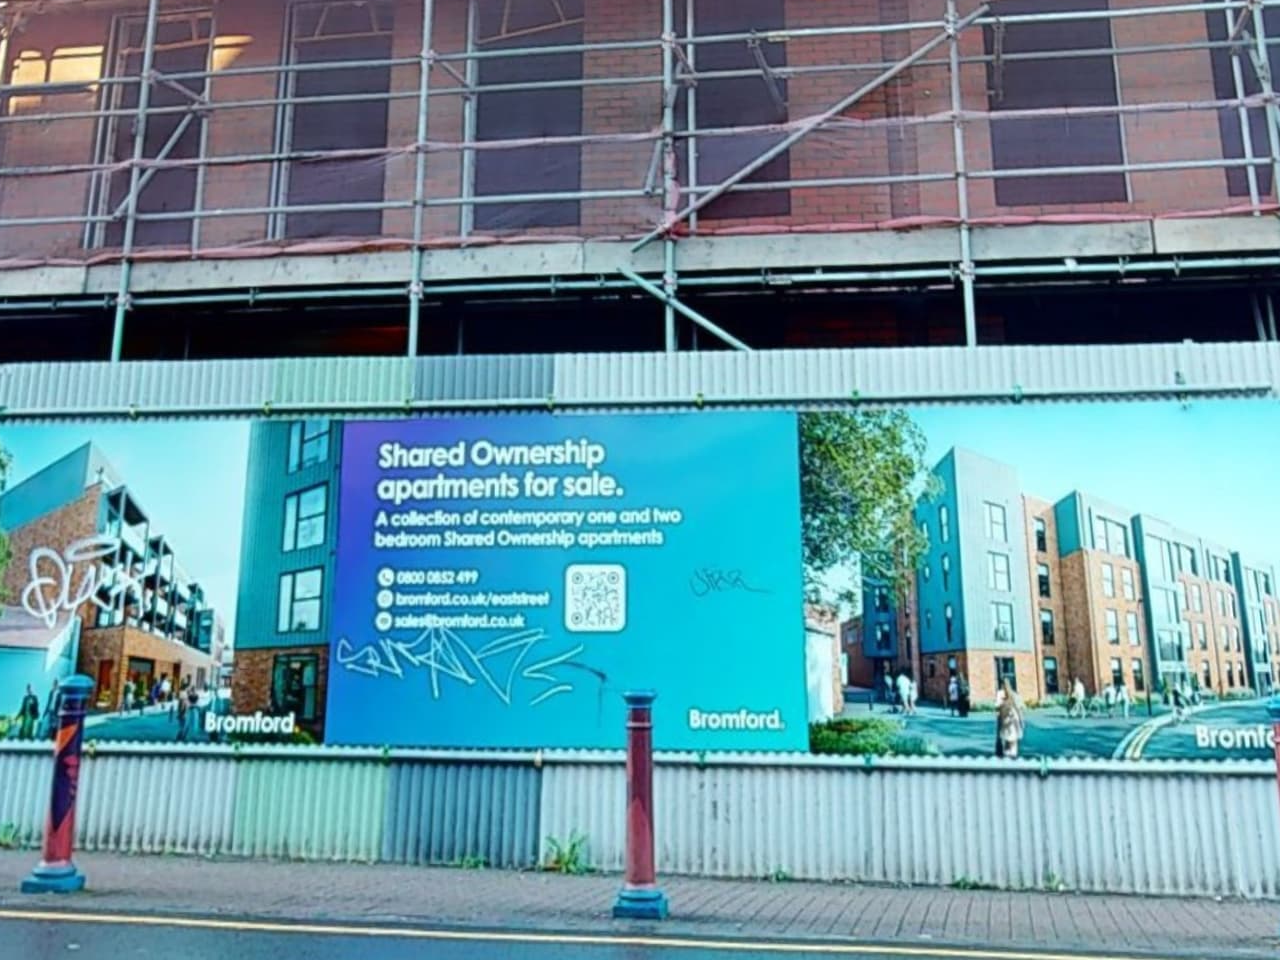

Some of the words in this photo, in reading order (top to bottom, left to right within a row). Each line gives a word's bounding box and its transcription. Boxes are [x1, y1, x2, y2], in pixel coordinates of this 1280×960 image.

[379, 441, 465, 468] Shared
[471, 438, 604, 470] Ownership
[377, 473, 519, 505] apartments
[524, 471, 559, 496] for
[563, 470, 623, 496] sale.
[375, 511, 388, 526] A
[391, 510, 460, 526] collection
[463, 510, 477, 524] of
[480, 510, 584, 528] contemporary
[587, 510, 616, 524] one
[620, 508, 650, 524] and
[653, 509, 681, 524] two
[375, 531, 440, 547] bedroom
[444, 530, 494, 547] Shared
[498, 530, 575, 549] Ownership
[578, 529, 664, 547] apartments
[205, 711, 299, 733] Bromford.
[689, 709, 785, 729] Bromford.
